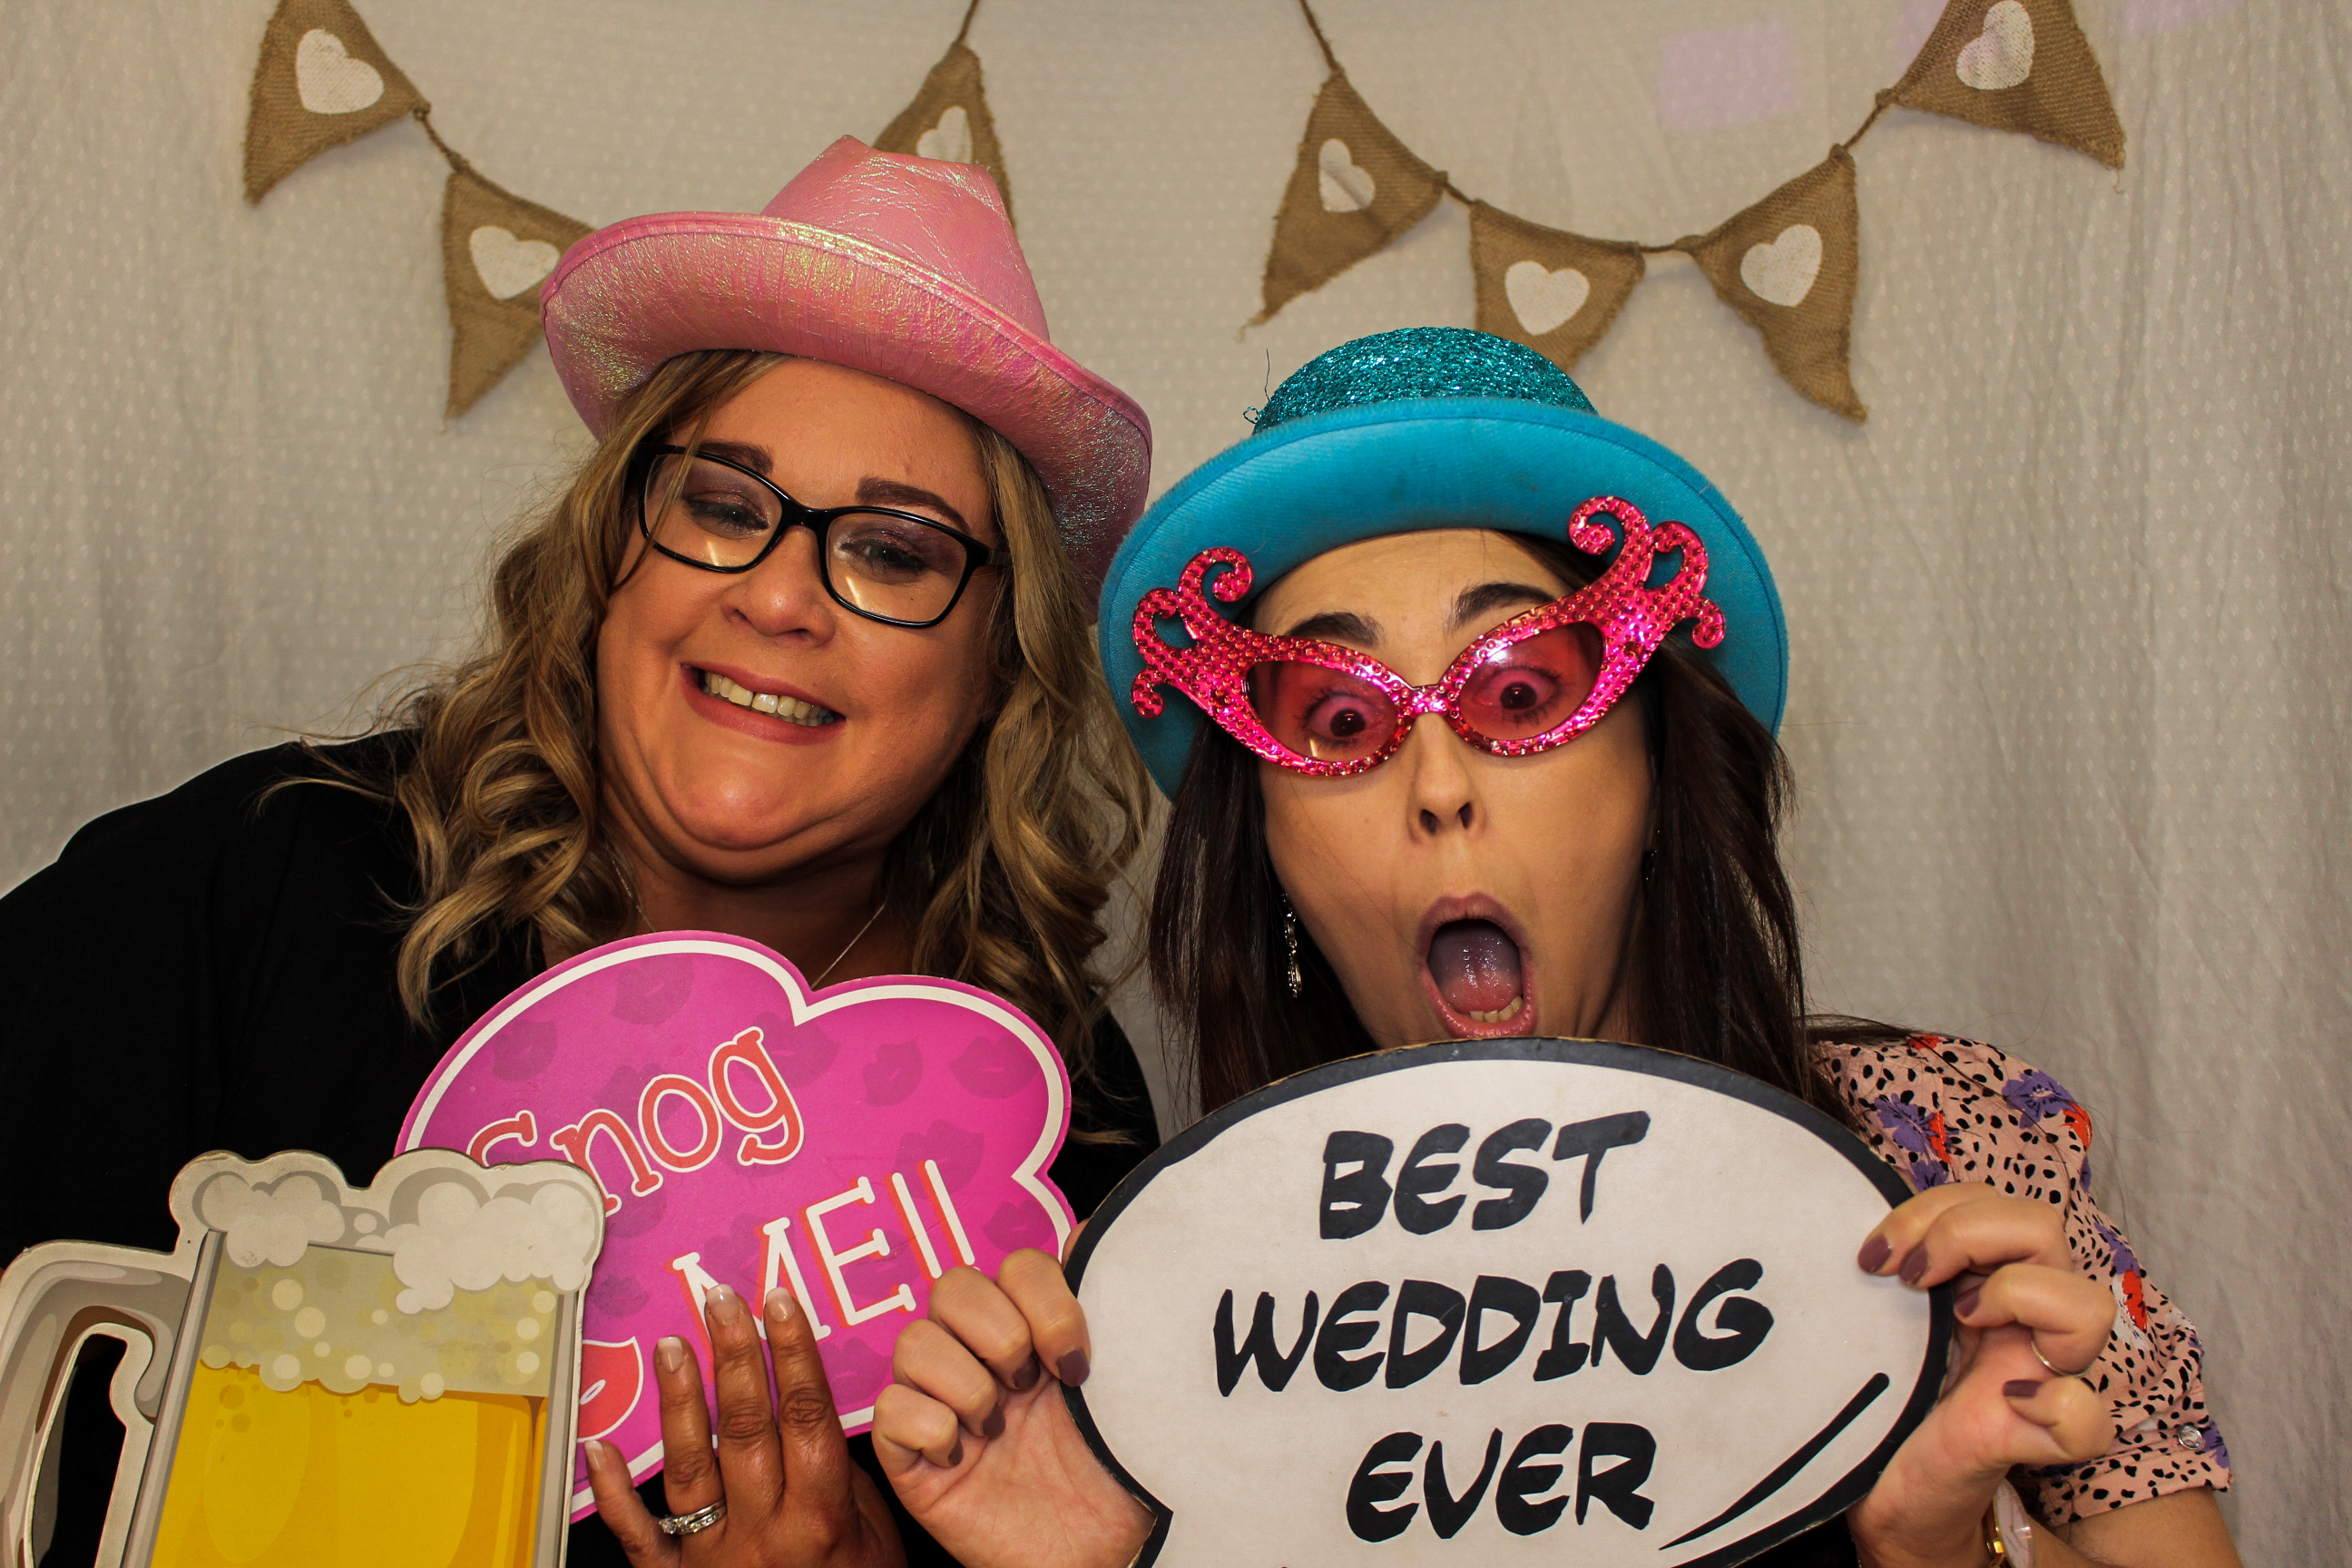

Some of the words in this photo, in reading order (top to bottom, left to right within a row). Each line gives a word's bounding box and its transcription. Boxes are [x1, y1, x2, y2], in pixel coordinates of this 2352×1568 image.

[1318, 1111, 1651, 1240] BEST
[1212, 1258, 1775, 1397] WEDDING
[1346, 1421, 1657, 1544] EVER
